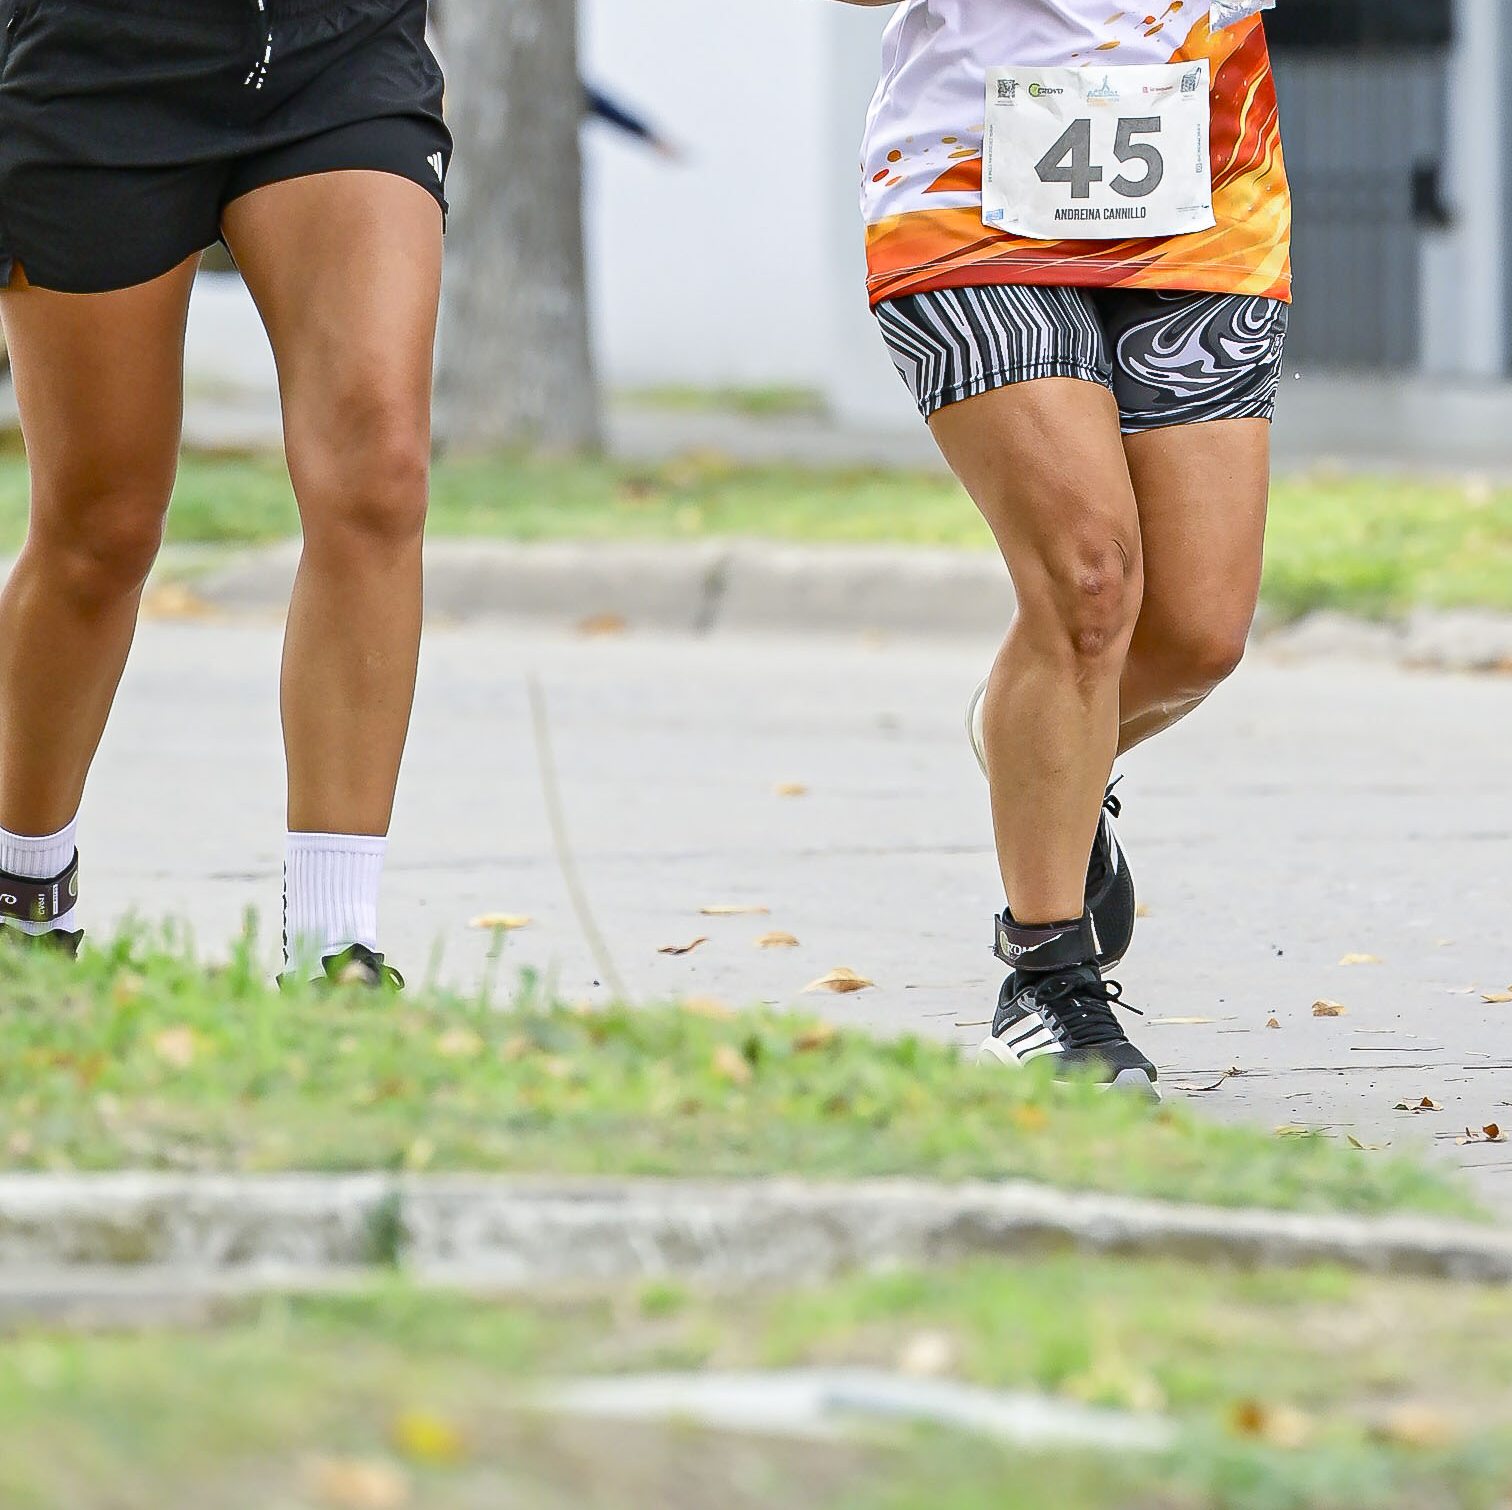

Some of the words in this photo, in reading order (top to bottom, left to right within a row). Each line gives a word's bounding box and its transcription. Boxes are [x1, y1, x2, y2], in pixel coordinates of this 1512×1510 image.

[1034, 116, 1163, 198] 45
[1054, 208, 1101, 221] ANDREINA
[1103, 206, 1147, 220] CANNILLO
